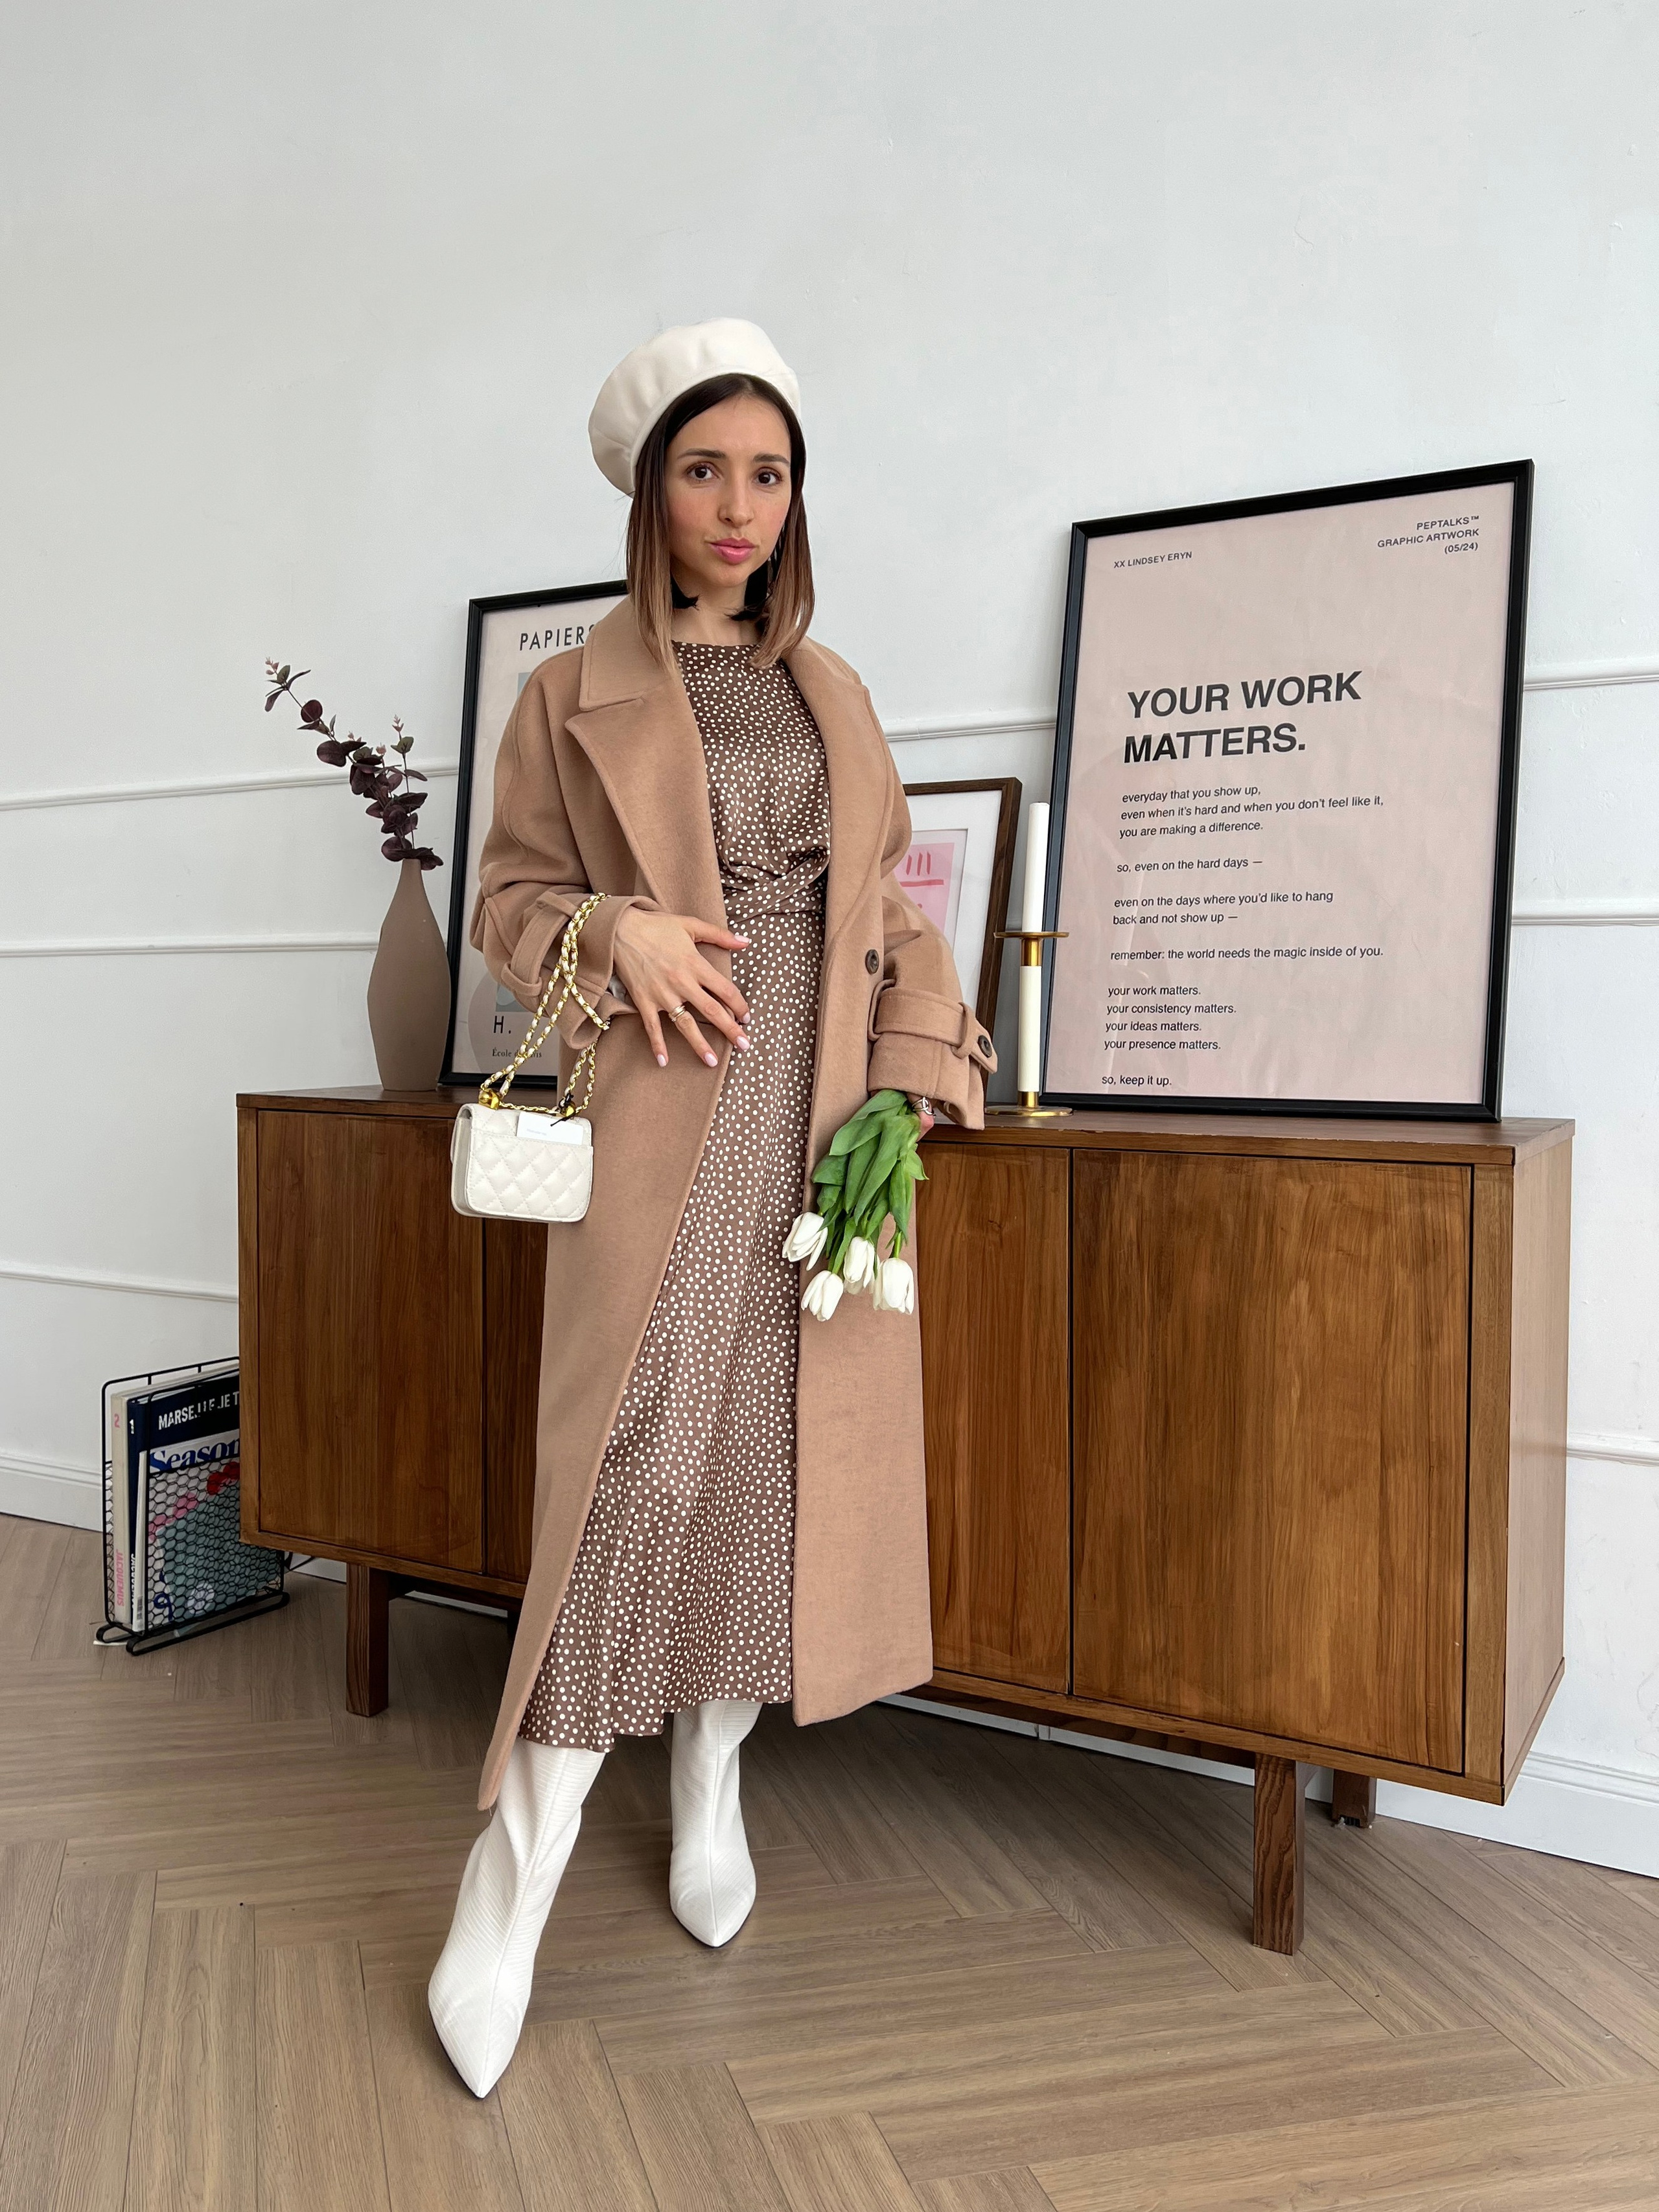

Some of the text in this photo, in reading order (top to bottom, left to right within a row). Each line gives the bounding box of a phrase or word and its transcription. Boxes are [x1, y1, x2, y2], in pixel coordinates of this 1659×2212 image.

[1377, 528, 1479, 548] GRAPHIC ARTWORK
[1444, 542, 1478, 555] (05/24)
[1113, 551, 1192, 569] XX LINDSEY ERYN
[1127, 671, 1363, 719] YOUR WORK
[1124, 722, 1306, 764] MATTERS.
[1122, 786, 1261, 804] everyday that you show up,
[1120, 811, 1145, 820] even
[1148, 808, 1175, 818] when
[1194, 804, 1218, 816] hard
[1220, 803, 1241, 814] and
[1244, 802, 1272, 812] when
[1275, 801, 1295, 813] you
[1328, 797, 1349, 808] feel
[1351, 796, 1371, 807] like
[1374, 795, 1384, 807] it,
[1119, 822, 1263, 840] you are making a difference.
[1117, 864, 1131, 873] so,
[1134, 862, 1159, 872] even
[1161, 862, 1175, 871] on
[1178, 860, 1194, 870] the
[1197, 858, 1221, 869] hard
[1223, 857, 1249, 870] days
[1114, 899, 1139, 908] even
[1141, 898, 1154, 907] on
[1157, 896, 1173, 906] the
[1175, 895, 1201, 908] days
[1203, 894, 1236, 904] where
[1270, 892, 1289, 903] like
[1292, 892, 1303, 902] to
[1305, 891, 1334, 903] hang
[1113, 914, 1137, 925] back
[1139, 914, 1159, 925] and
[1161, 913, 1178, 923] not
[1180, 913, 1209, 923] show
[1211, 914, 1224, 925] up
[1110, 945, 1384, 961] remember: the world needs the magic inside of you.
[1108, 985, 1201, 998] your work matters.
[1106, 1003, 1237, 1015] your consistency matters.
[493, 1015, 511, 1034] H.
[1105, 1020, 1202, 1033] your ideas matters.
[492, 1047, 512, 1057] École
[1104, 1040, 1222, 1051] your presence matters.
[1101, 1074, 1172, 1088] so, keep it up.
[217, 1394, 230, 1409] JE
[115, 1549, 125, 1607] JACQUEMUS
